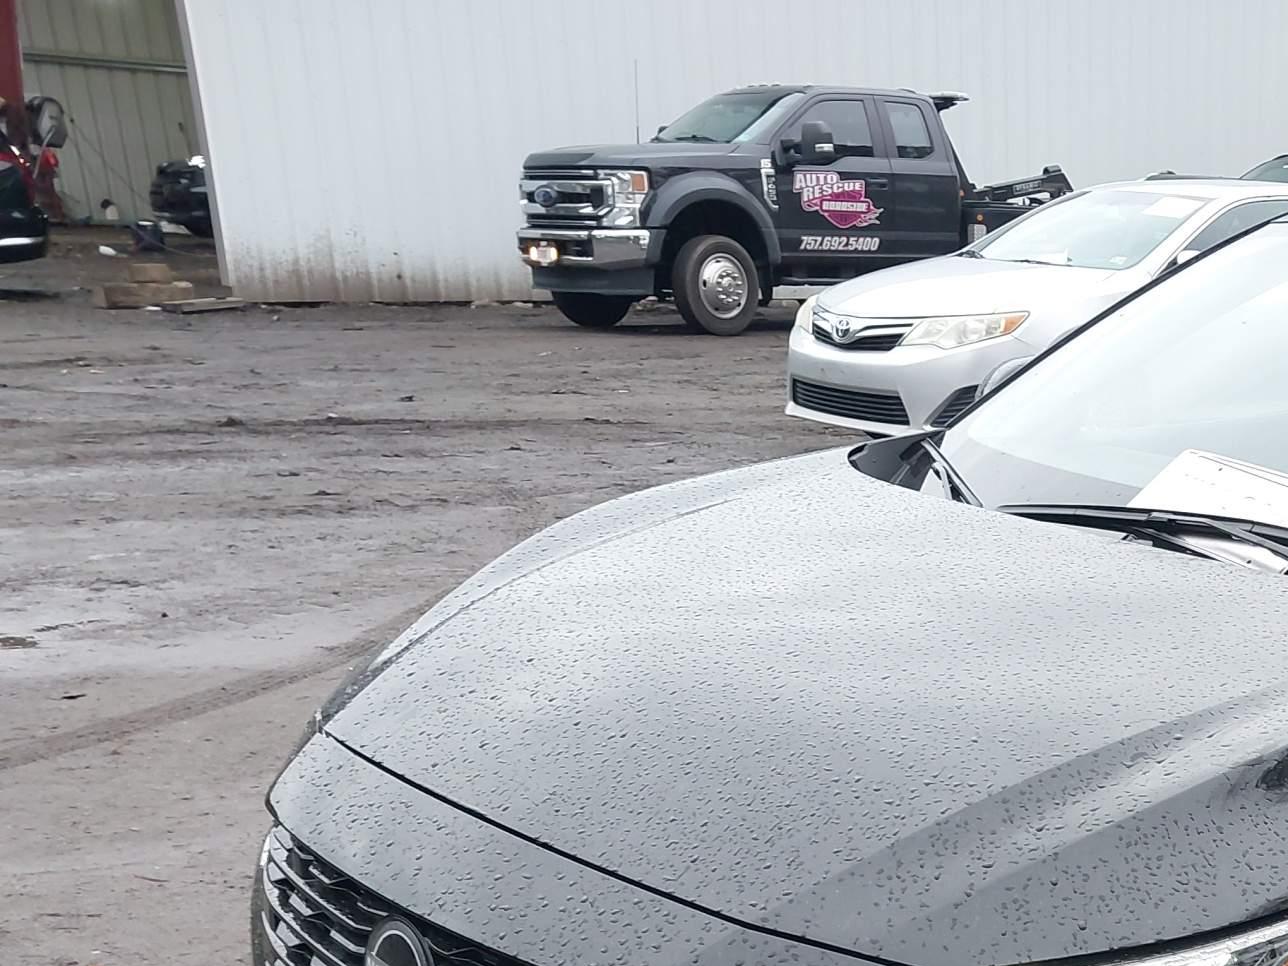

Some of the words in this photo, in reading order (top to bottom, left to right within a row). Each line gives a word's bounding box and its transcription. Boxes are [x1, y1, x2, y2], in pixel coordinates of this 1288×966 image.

[795, 173, 837, 189] AUTO
[803, 182, 862, 202] RESCUE
[800, 236, 880, 251] 757.692.5400
